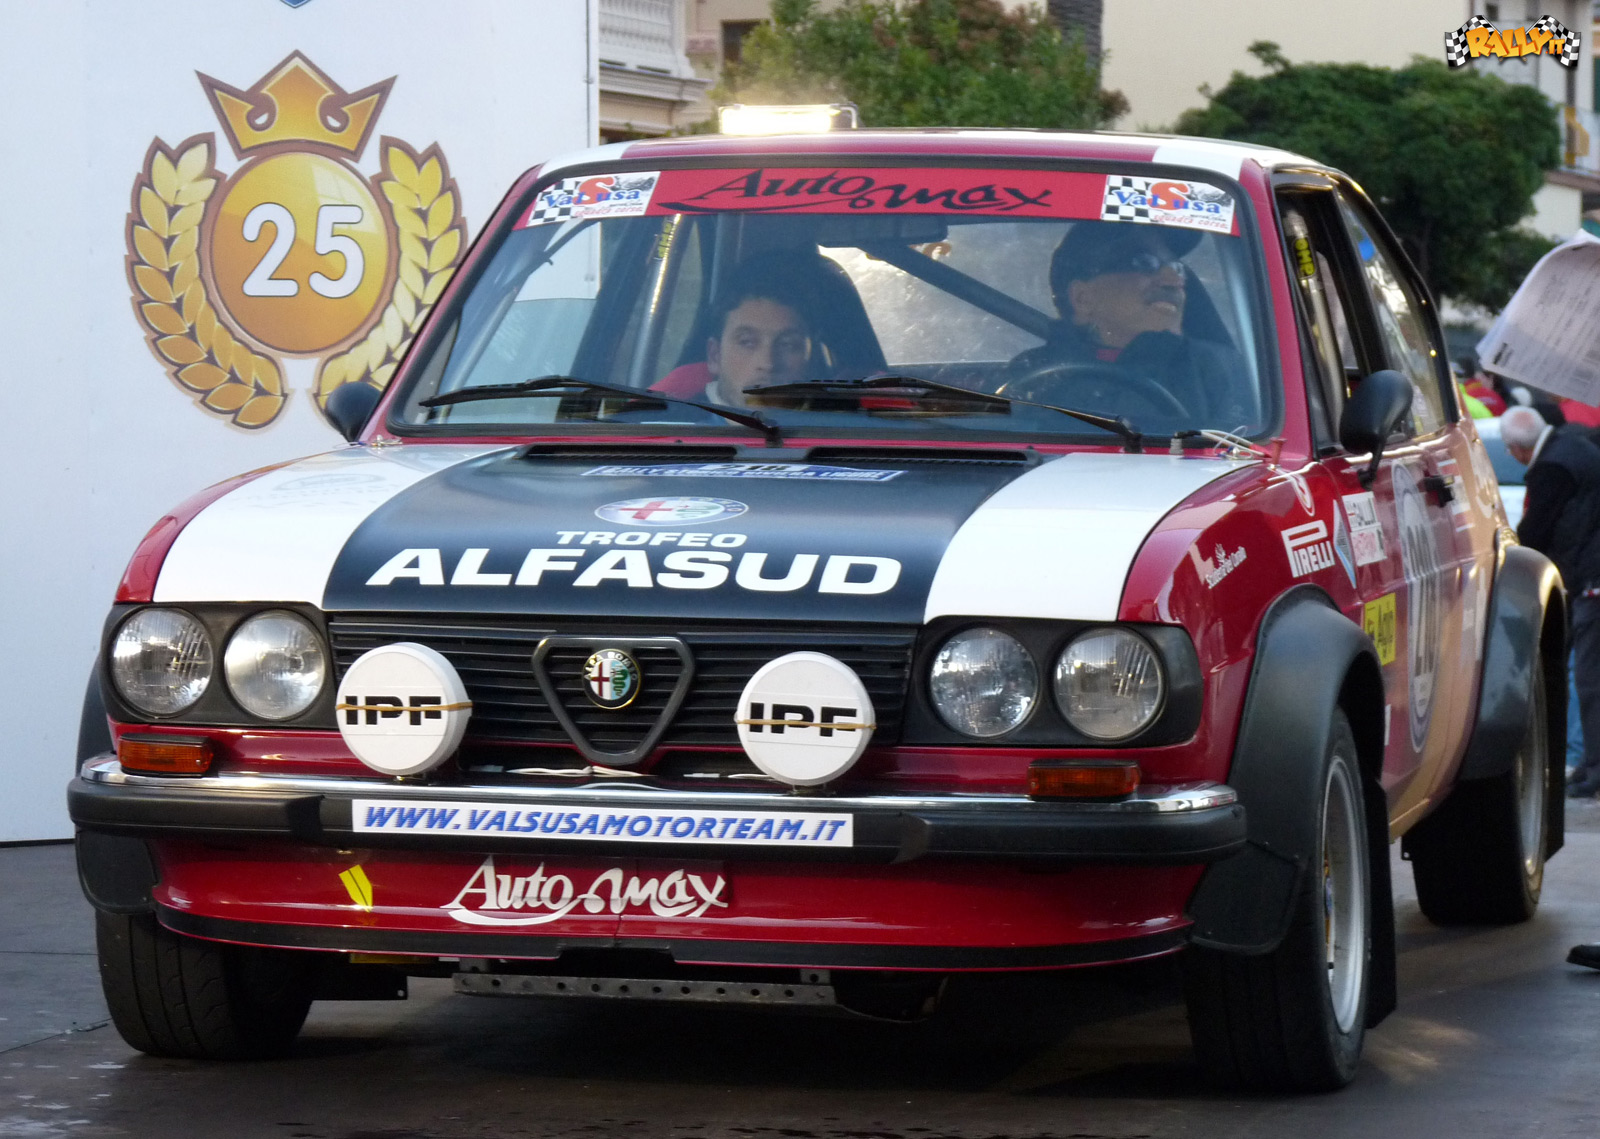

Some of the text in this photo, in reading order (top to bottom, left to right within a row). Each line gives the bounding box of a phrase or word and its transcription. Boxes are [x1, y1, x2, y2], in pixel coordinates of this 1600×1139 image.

[242, 202, 365, 299] 25
[556, 530, 748, 549] TROFEO
[1280, 519, 1335, 578] PIRELLI
[366, 548, 903, 595] ALFASUD
[345, 695, 442, 725] IPF
[749, 702, 857, 737] IPF
[364, 805, 846, 842] WWW.VALSUSAMOTORTEAM.IT
